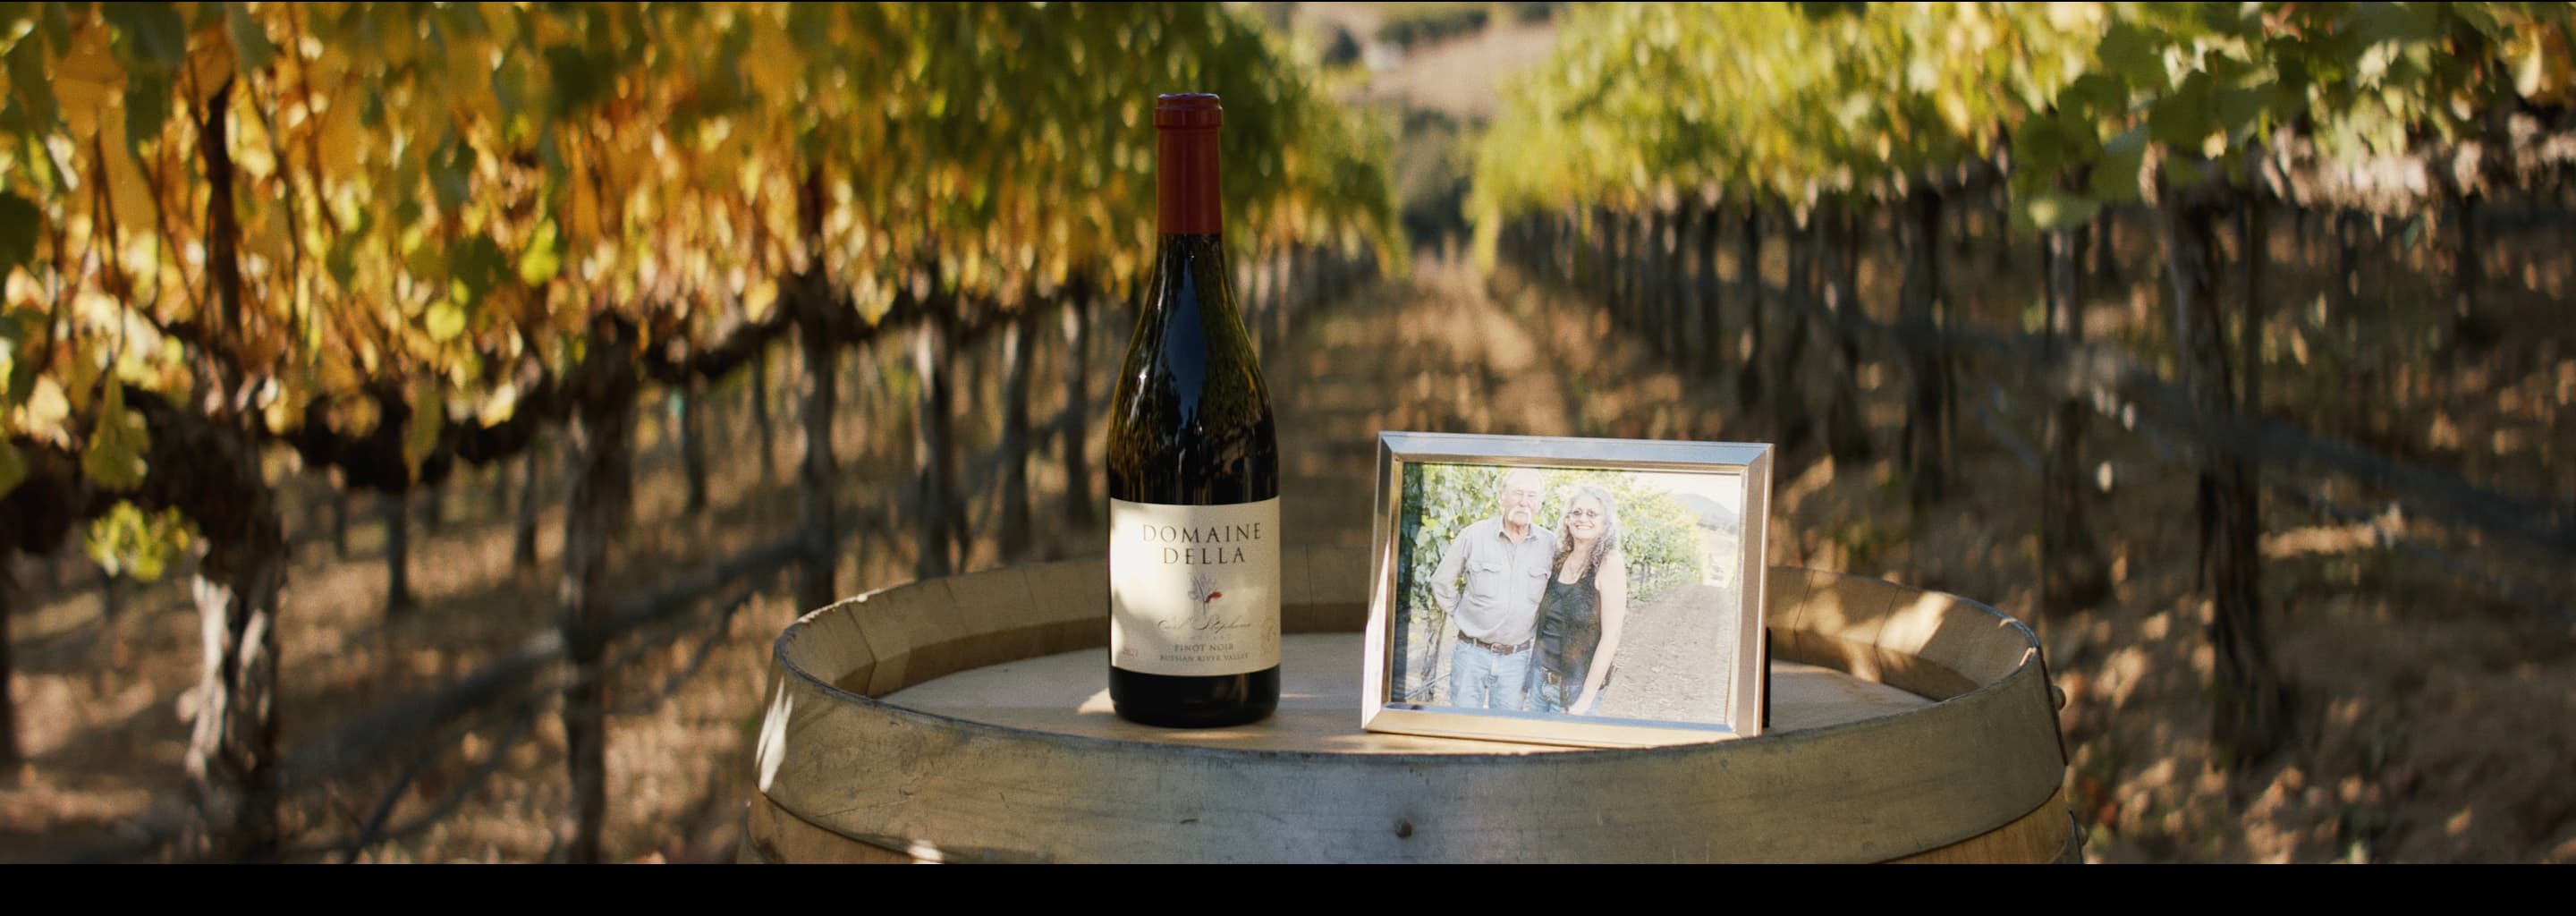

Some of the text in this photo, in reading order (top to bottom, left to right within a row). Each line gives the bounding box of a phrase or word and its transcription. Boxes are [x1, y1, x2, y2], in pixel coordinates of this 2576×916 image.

[1142, 522, 1262, 544] DOMAINE
[1163, 547, 1246, 565] DELLA
[1174, 642, 1234, 653] PINOT NOIR
